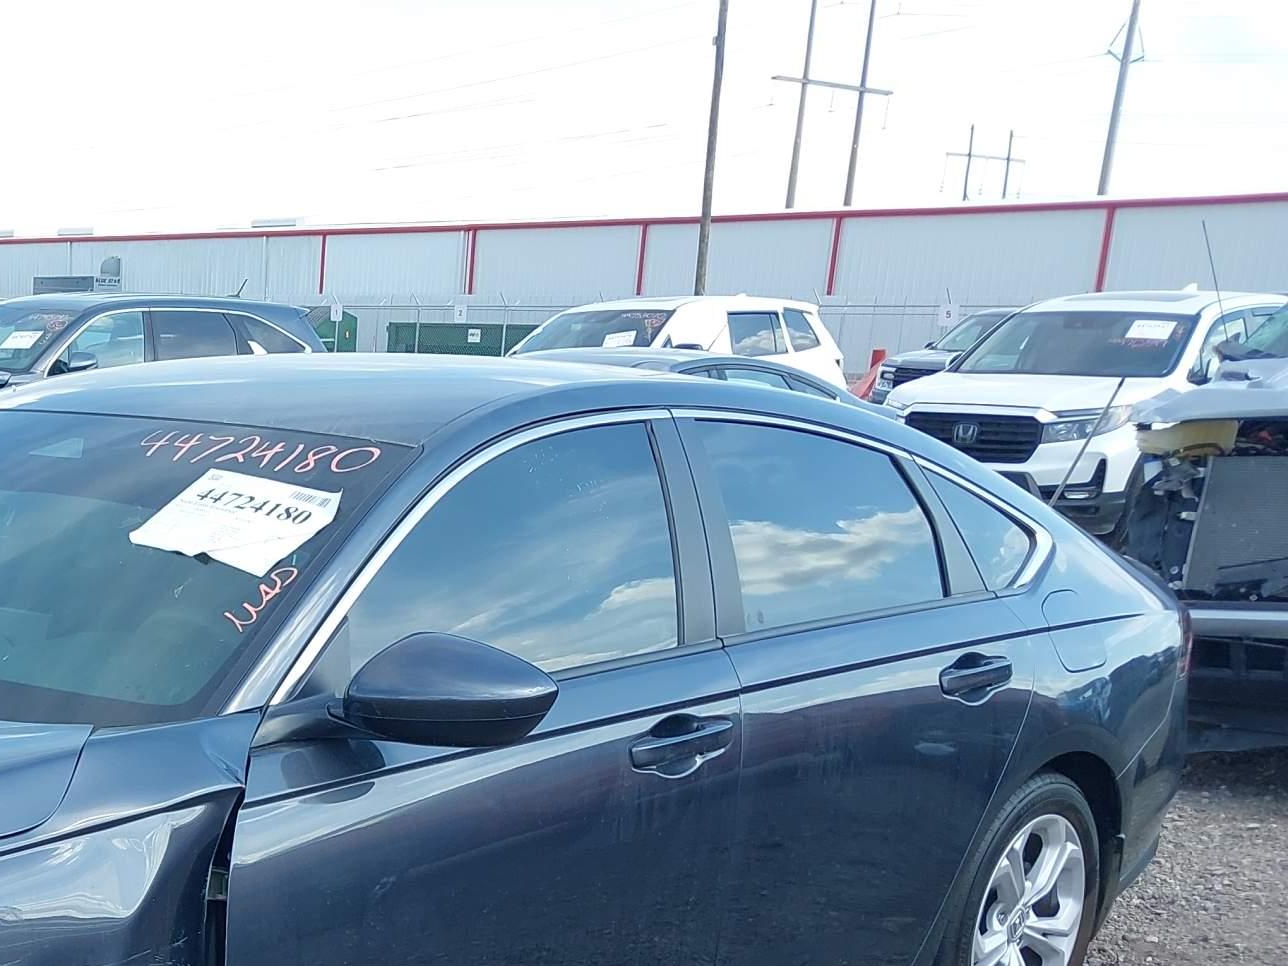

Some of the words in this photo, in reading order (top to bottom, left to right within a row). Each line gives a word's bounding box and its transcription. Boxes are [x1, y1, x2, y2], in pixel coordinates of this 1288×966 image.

[945, 310, 952, 318] 5
[140, 430, 381, 473] 44724180
[196, 488, 312, 524] 44724180
